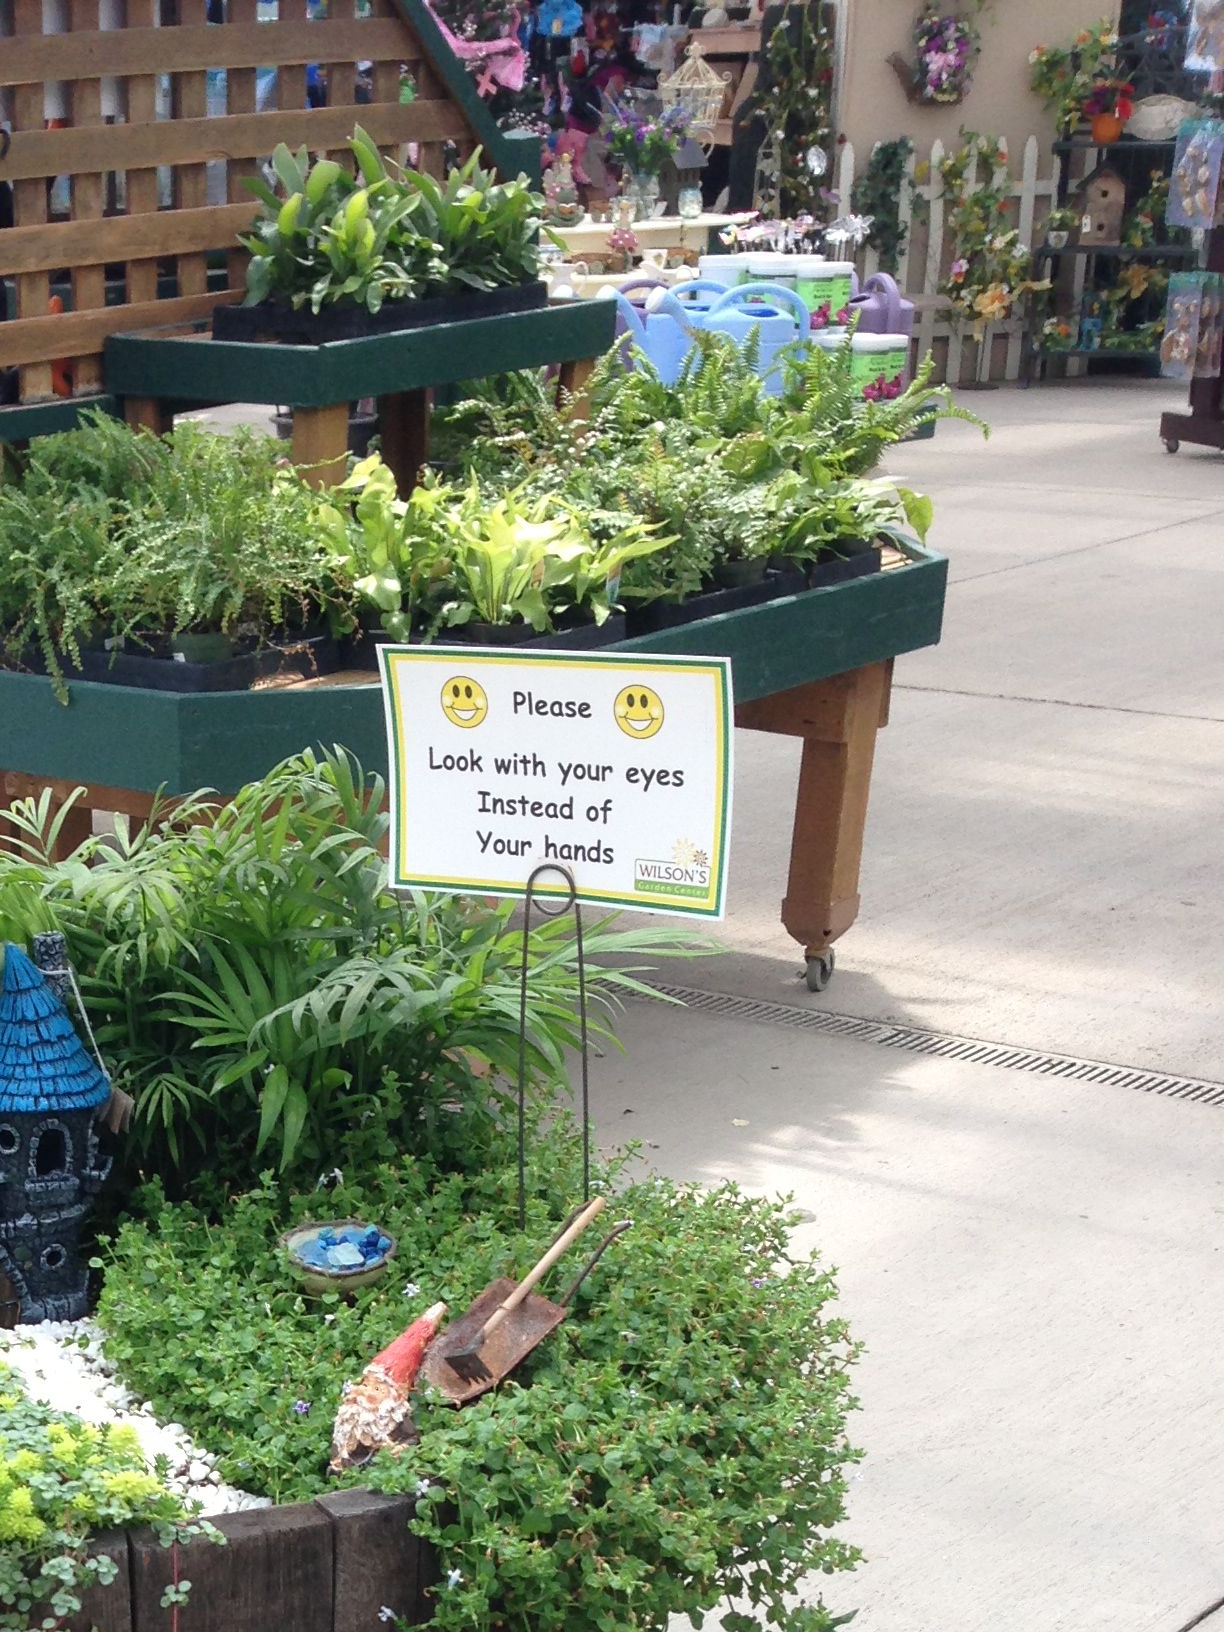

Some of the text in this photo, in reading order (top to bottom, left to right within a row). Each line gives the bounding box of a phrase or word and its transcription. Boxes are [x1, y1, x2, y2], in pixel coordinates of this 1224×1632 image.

[513, 691, 592, 719] Please
[429, 746, 684, 792] Look with your eyes
[477, 790, 613, 824] Instead of
[476, 830, 614, 864] Your hands
[638, 881, 672, 892] Garden
[639, 864, 707, 884] WILSON'S
